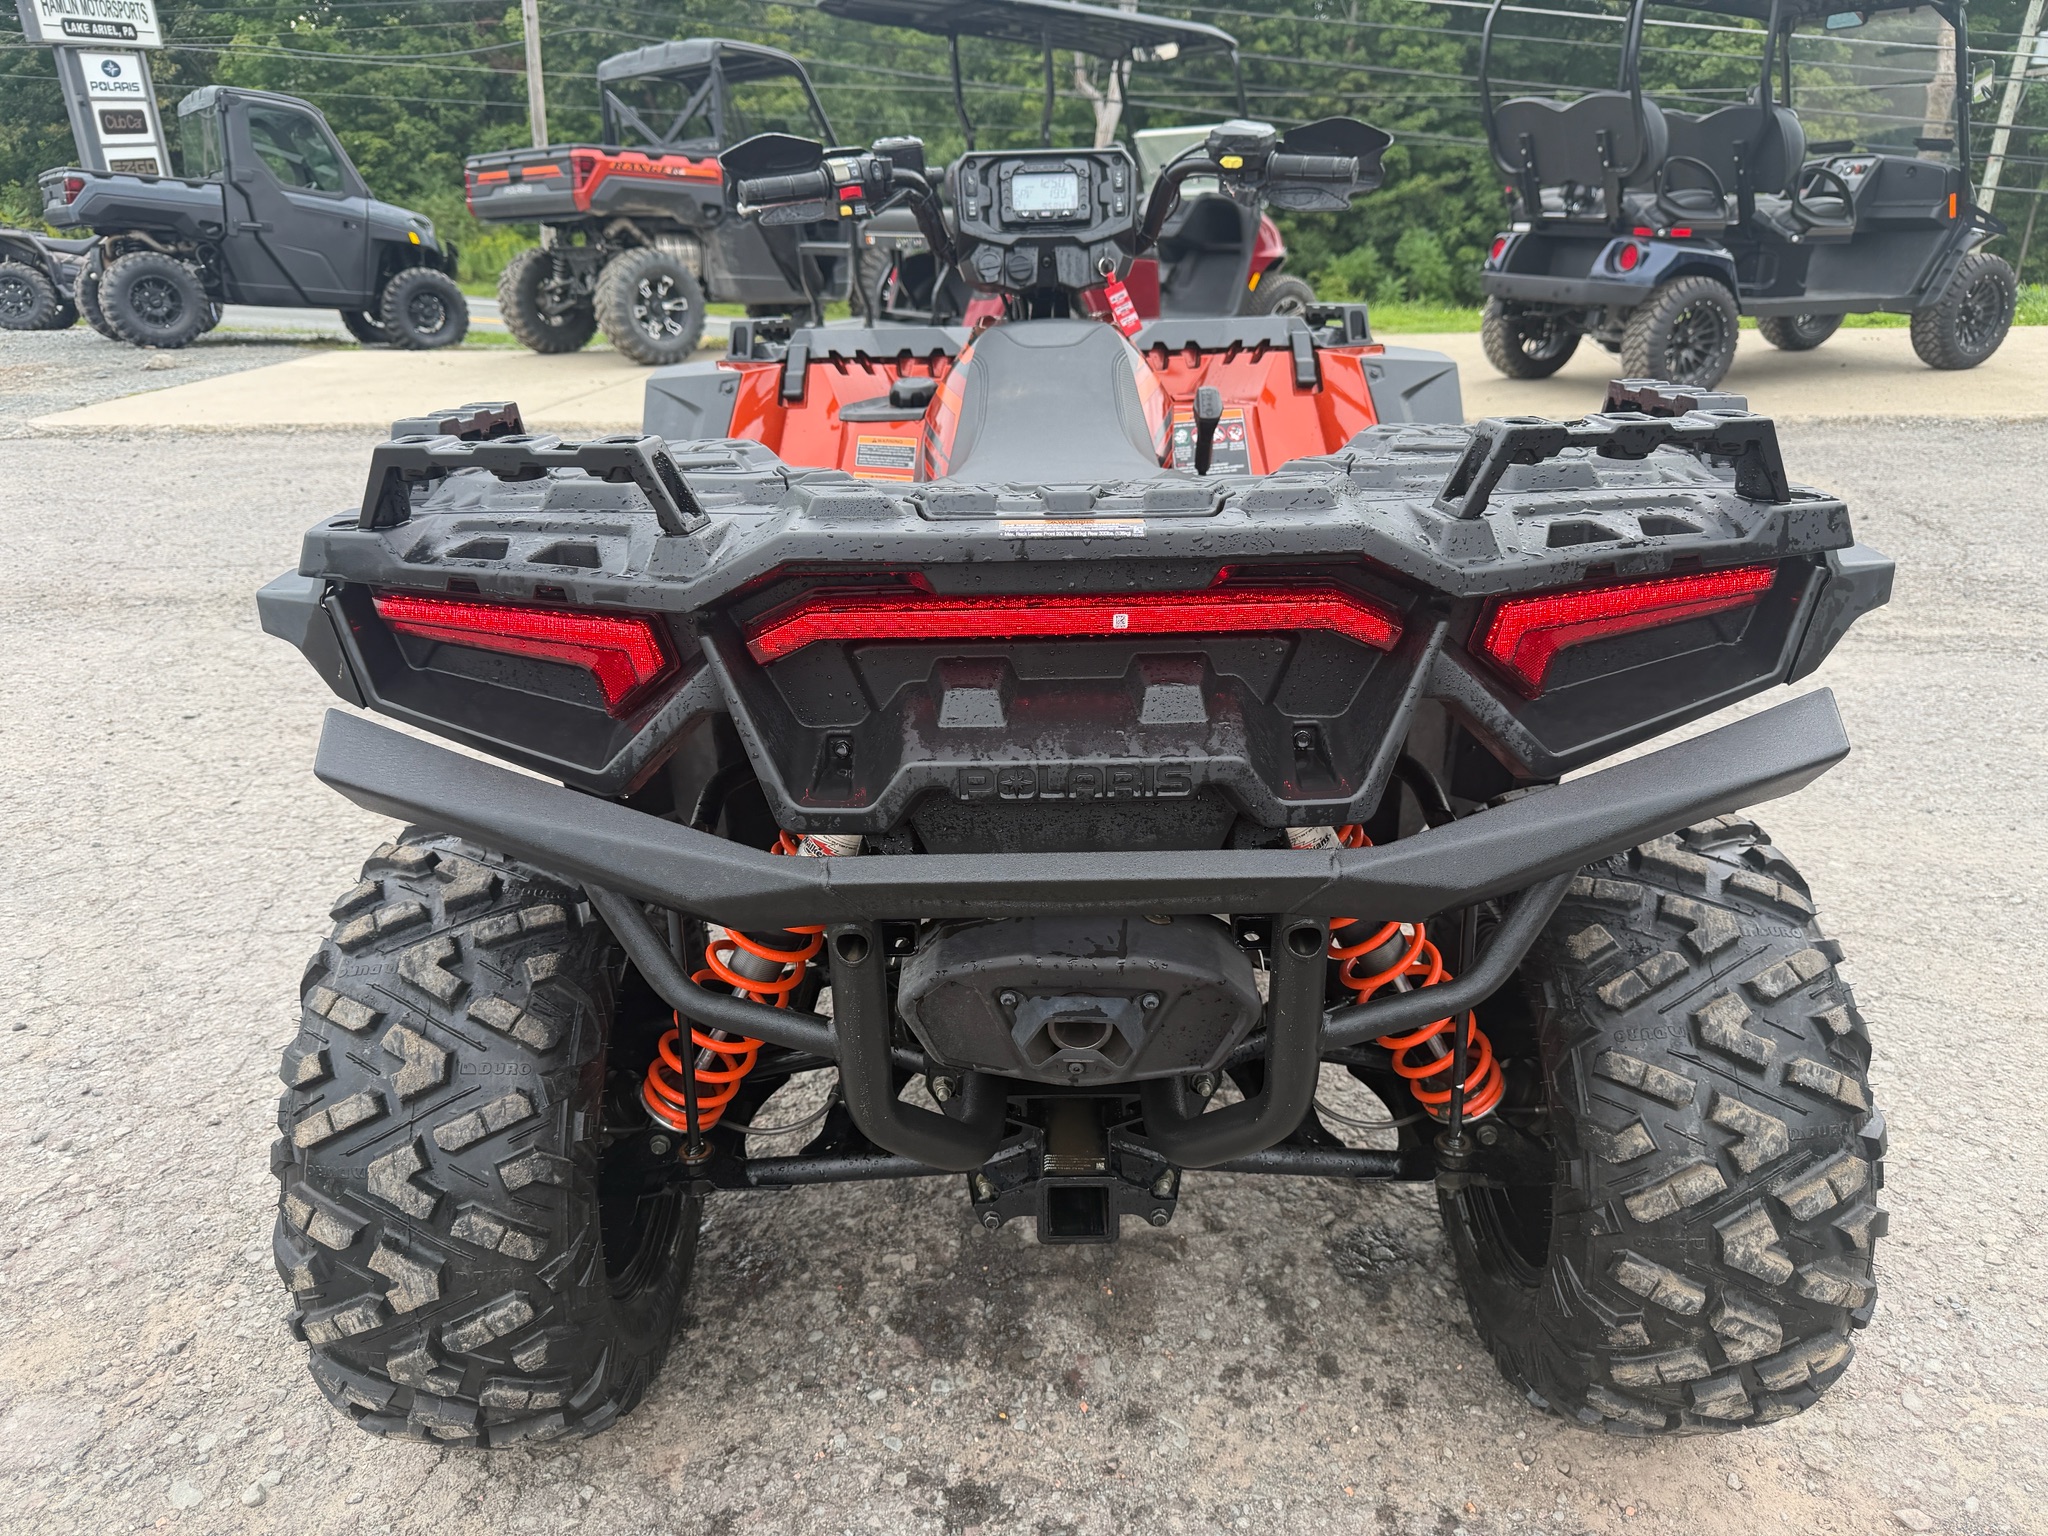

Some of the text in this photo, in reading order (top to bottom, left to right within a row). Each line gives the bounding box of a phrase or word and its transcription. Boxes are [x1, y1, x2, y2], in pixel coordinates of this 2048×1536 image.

[41, 0, 149, 23] HAMLIN MOTORSPORTS
[64, 22, 135, 37] LAKE ARIEL, PA
[90, 81, 140, 91] POLARIS
[104, 114, 143, 129] Club Car
[958, 764, 1193, 800] POLARIS
[1613, 1026, 1668, 1043] DURO
[478, 1062, 532, 1076] DURO
